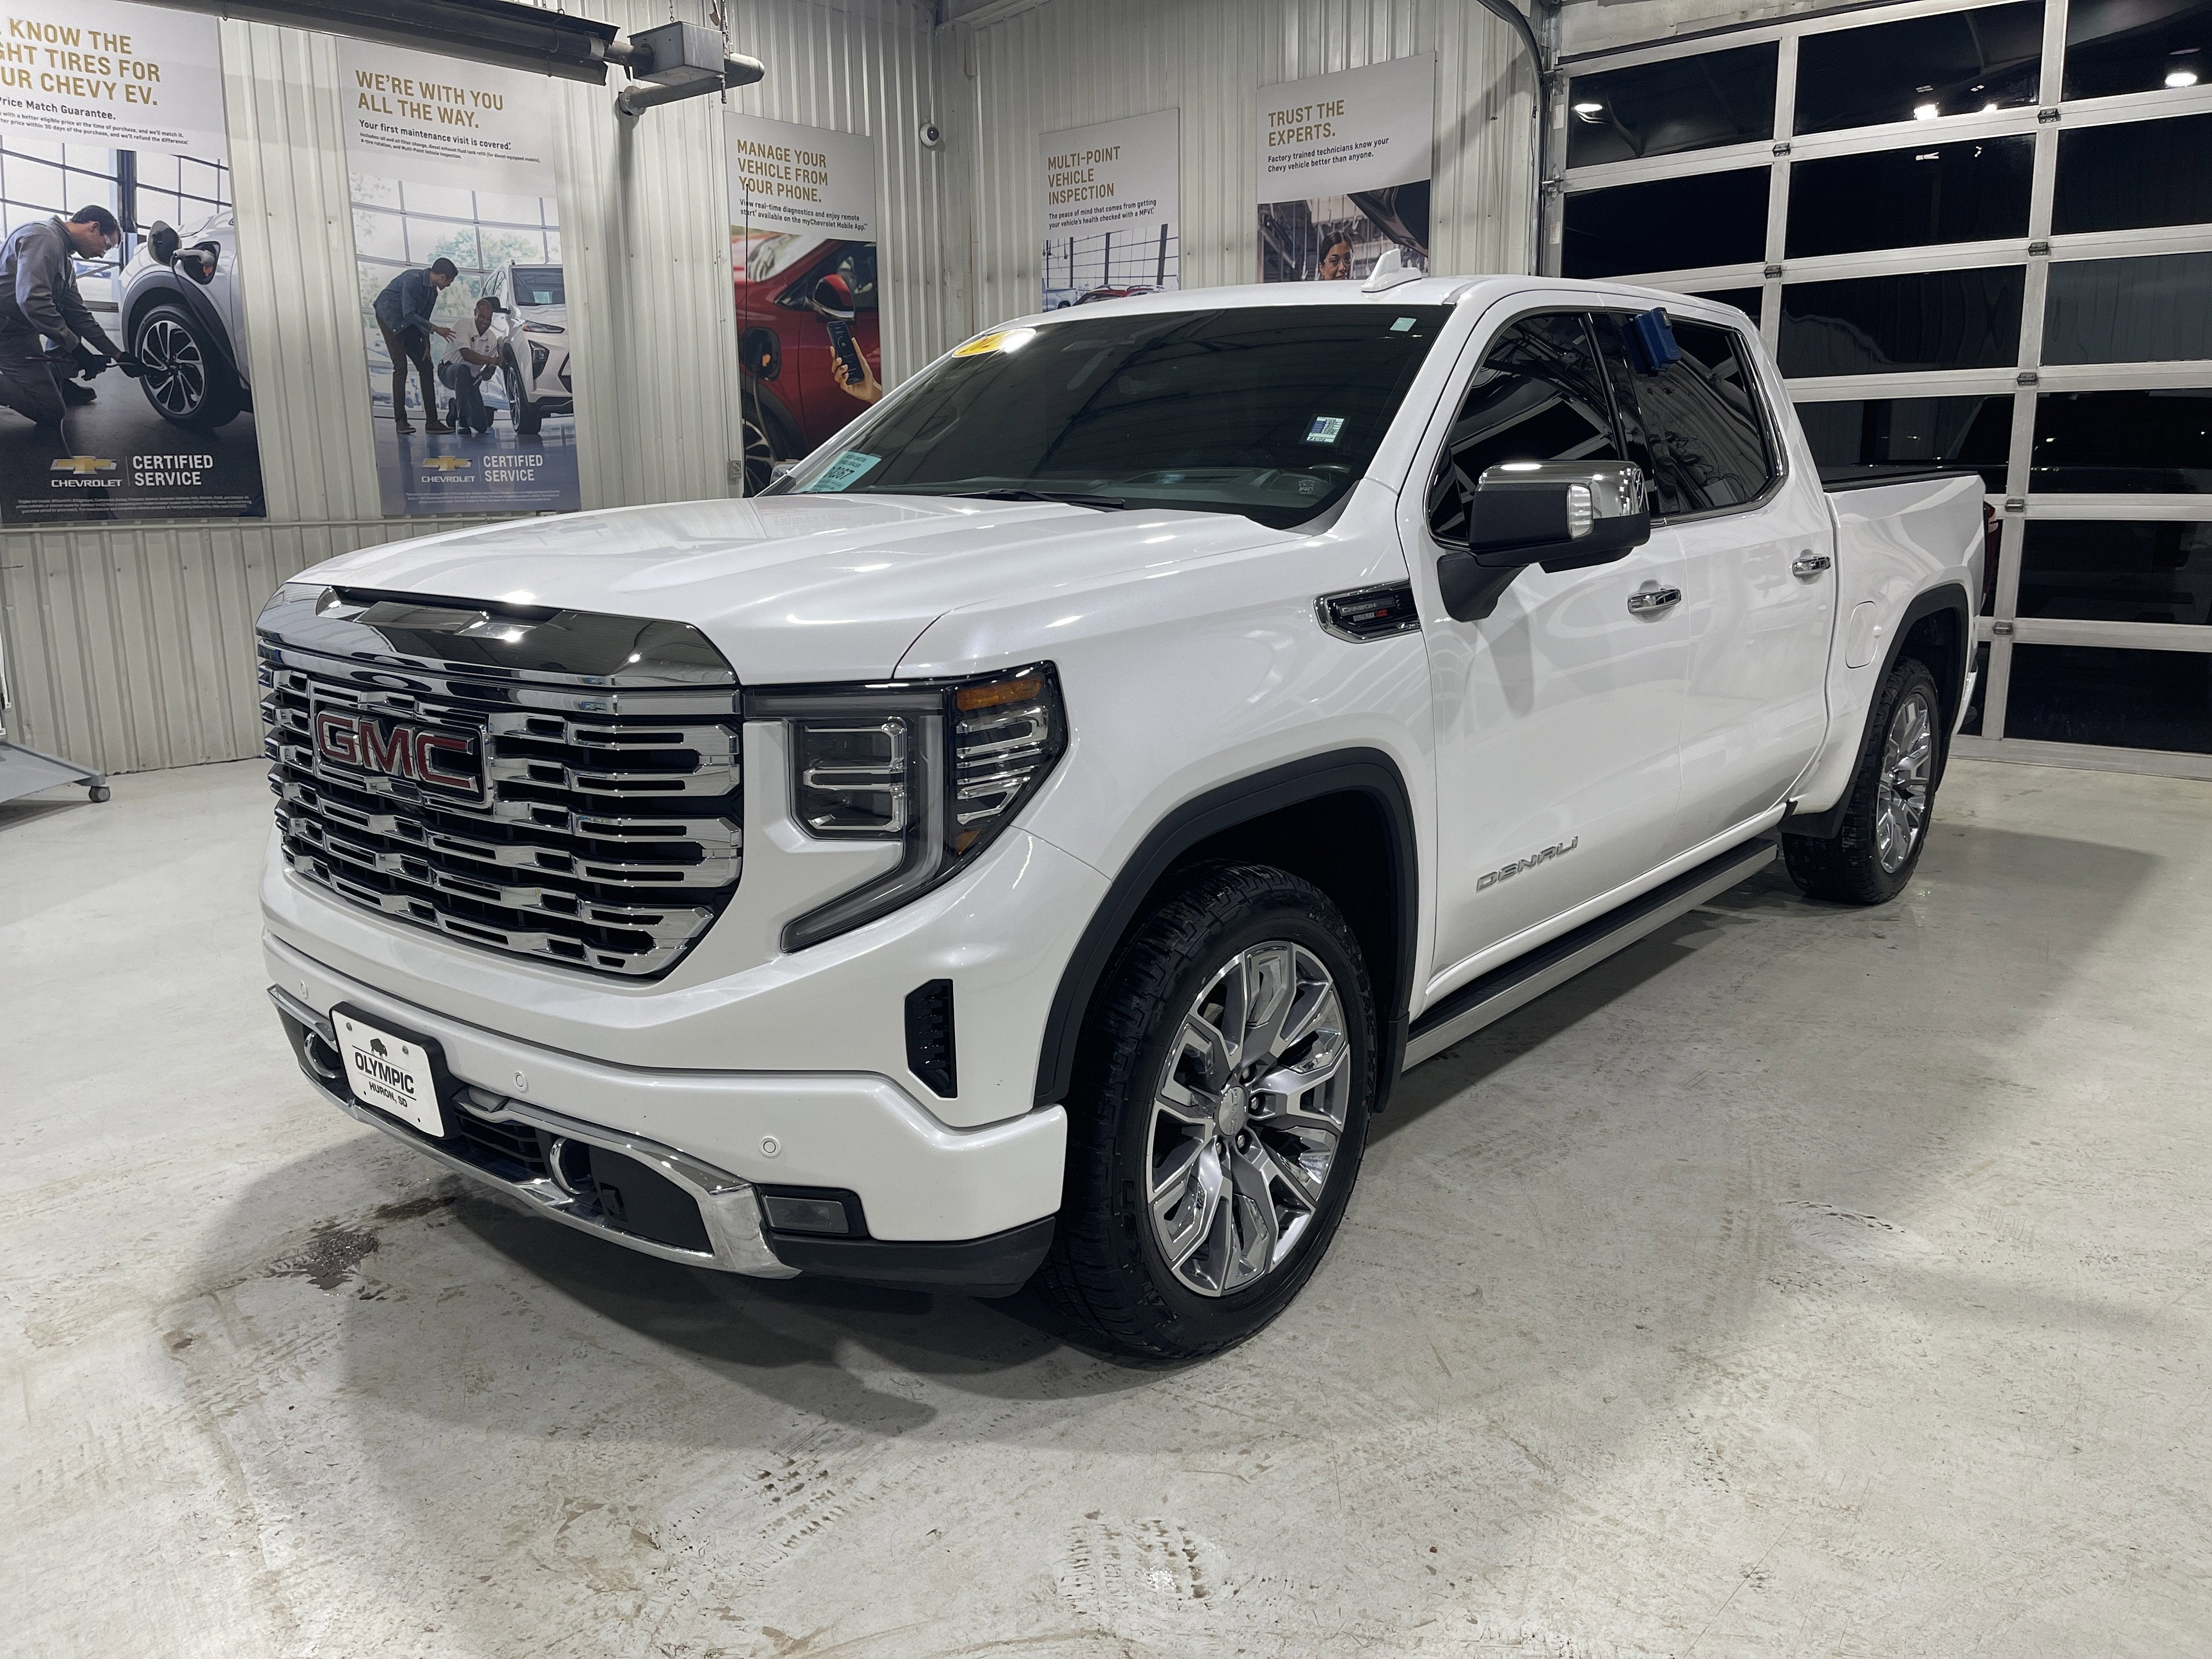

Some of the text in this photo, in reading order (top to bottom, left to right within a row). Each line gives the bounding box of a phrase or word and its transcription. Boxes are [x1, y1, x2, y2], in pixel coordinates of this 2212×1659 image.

[10, 18, 132, 55] KNOW THE
[44, 48, 111, 76] TIRES
[119, 59, 161, 82] FOR
[1, 66, 157, 105] UR CHEVY EV.
[355, 70, 503, 111] WE'RE WITH YOU
[26, 100, 58, 112] Match
[61, 105, 116, 120] Guarantee.
[358, 92, 479, 128] ALL THE WAY.
[1268, 99, 1345, 127] TRUST THE
[359, 119, 378, 130] Your
[381, 123, 399, 134] first
[400, 128, 451, 142] maintenance
[453, 136, 469, 145] visit
[471, 138, 477, 146] is
[1268, 122, 1336, 147] EXPERTS.
[737, 139, 826, 168] MANAGE YOUR
[1048, 145, 1120, 171] MULTI-POINT
[1268, 137, 1390, 163] Factory trained technicians know your
[1268, 151, 1374, 173] Chevy vehicle better than anyone.
[737, 157, 828, 186] VEHICLE FROM
[1048, 168, 1094, 188] VEHICLE
[738, 176, 822, 202] YOUR PHONE.
[1048, 183, 1114, 205] INSPECTION
[755, 202, 781, 212] real-time
[783, 206, 814, 216] diagnostics
[826, 212, 840, 221] enjoy
[758, 212, 782, 221] available
[802, 218, 836, 228] myChevrolet
[1080, 206, 1093, 215] mind
[1137, 199, 1156, 210] getting
[1048, 221, 1060, 230] your
[1061, 218, 1082, 227] vehicle's
[1082, 216, 1099, 224] health
[1099, 213, 1121, 222] checked
[132, 455, 213, 470] CERTIFIED
[483, 454, 543, 468] CERTIFIED
[51, 479, 122, 487] CHEVROLET
[134, 471, 202, 487] SERVICE
[484, 469, 535, 482] SERVICE
[317, 709, 479, 793] GMC
[1476, 836, 1578, 891] DENALI
[354, 1052, 414, 1094] OLYMPIC
[369, 1081, 408, 1108] HURON, SD
